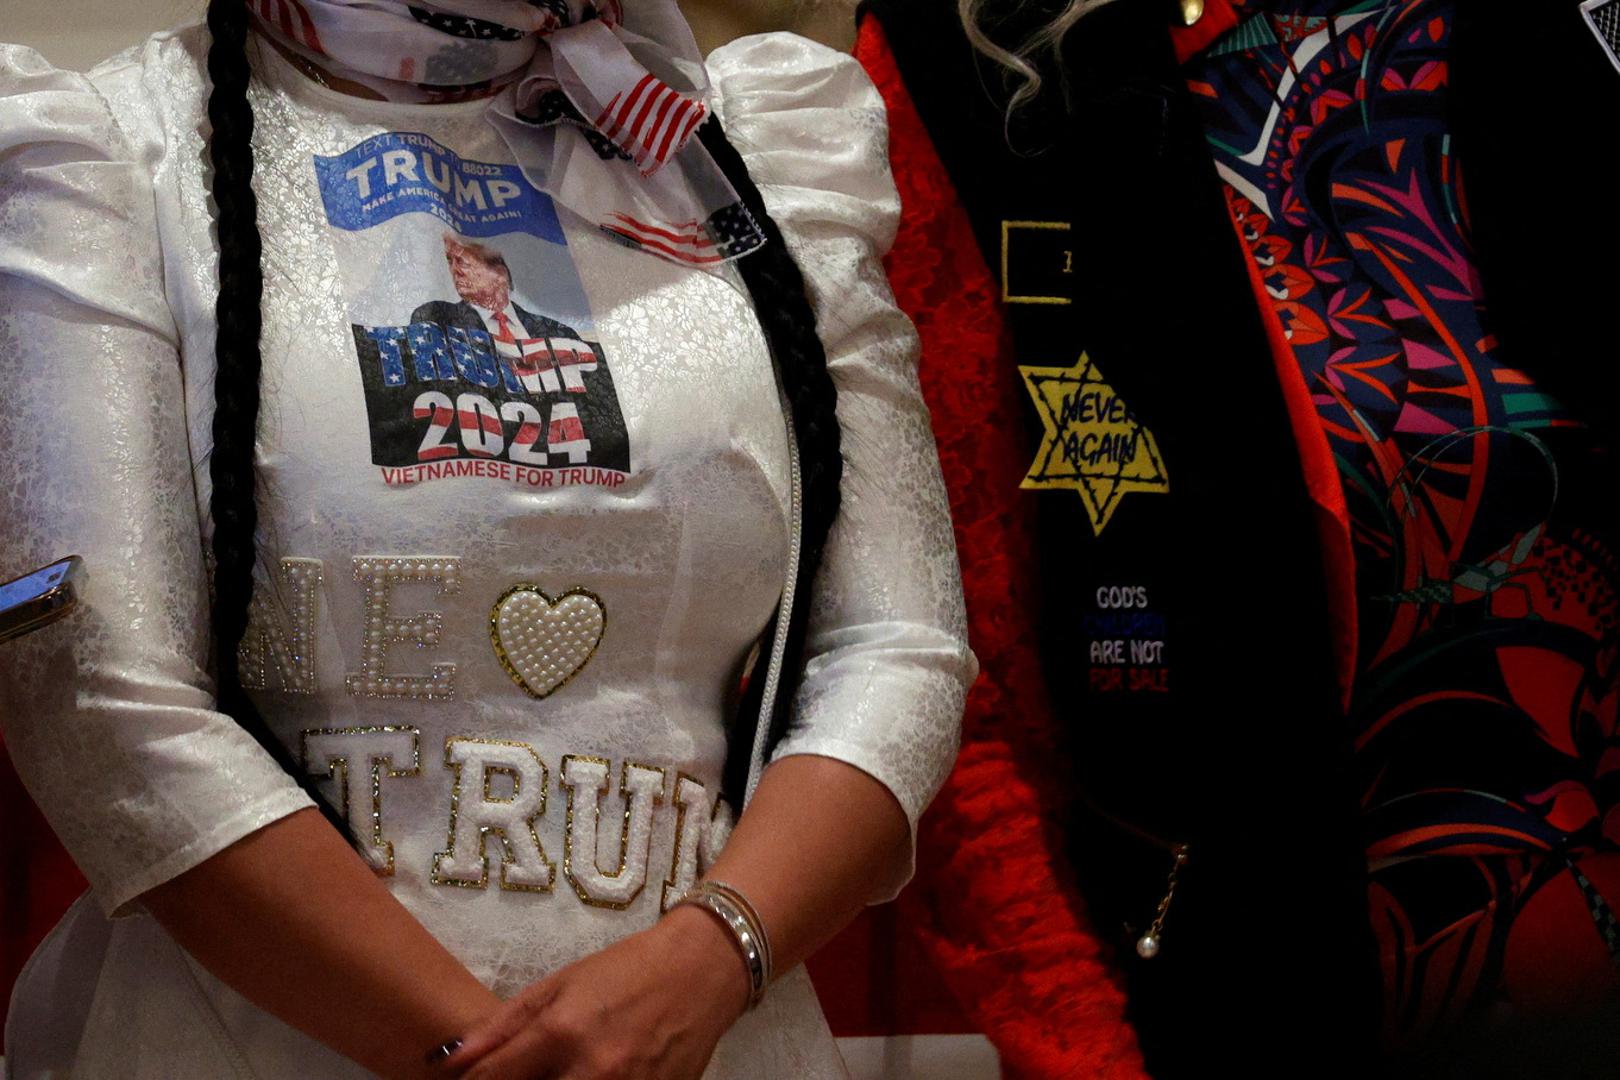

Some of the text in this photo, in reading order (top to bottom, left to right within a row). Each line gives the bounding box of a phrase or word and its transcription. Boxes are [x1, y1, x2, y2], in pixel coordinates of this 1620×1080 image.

[346, 149, 522, 211] TRUMP
[362, 192, 395, 213] MAKE
[480, 210, 522, 224] AGAIN!
[364, 321, 598, 394] TRUMP
[413, 391, 592, 466] 2024
[1063, 433, 1137, 466] AGAIN
[381, 460, 626, 489] VIETNAMESE FOR TRUMP
[1096, 585, 1148, 609] GOD'S
[1090, 638, 1165, 665] ARE NOT
[1088, 666, 1169, 693] FOR SALE
